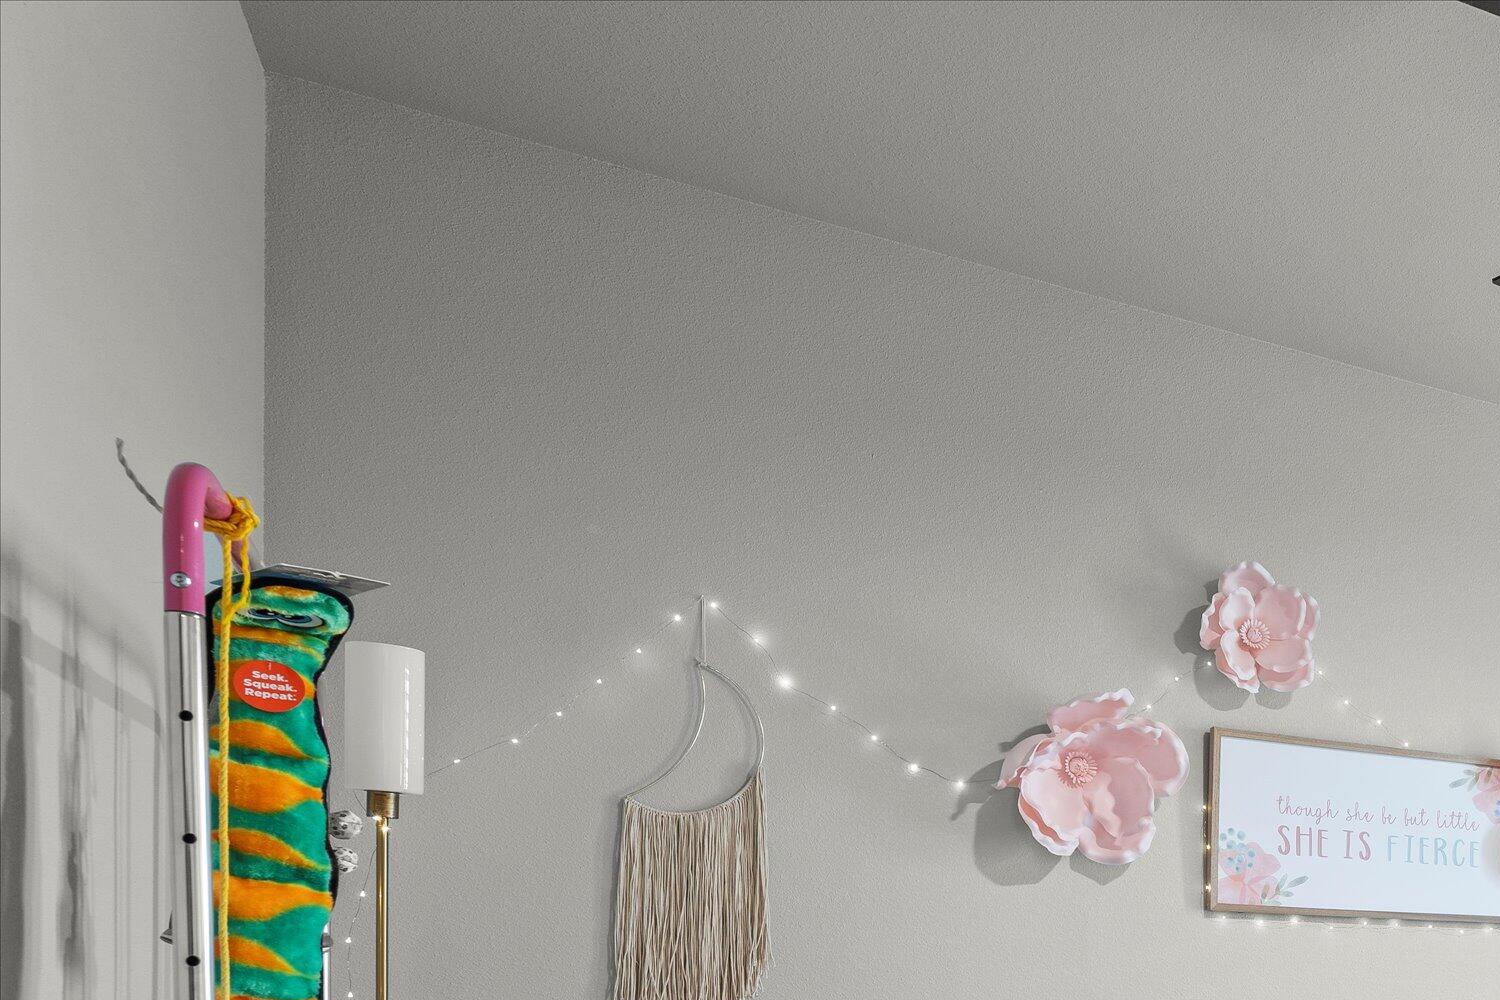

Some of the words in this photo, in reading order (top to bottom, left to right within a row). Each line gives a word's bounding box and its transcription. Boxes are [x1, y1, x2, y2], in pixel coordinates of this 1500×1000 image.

[252, 670, 289, 682] Seek.
[243, 678, 298, 693] Squeak.
[244, 687, 297, 701] Repeat.
[1276, 795, 1339, 825] though
[1345, 801, 1374, 823] she
[1381, 806, 1397, 825] be
[1404, 807, 1429, 826] but
[1436, 809, 1480, 831] little
[1277, 824, 1329, 858] SHE
[1342, 829, 1371, 861] IS
[1387, 834, 1481, 869] FIERCE
